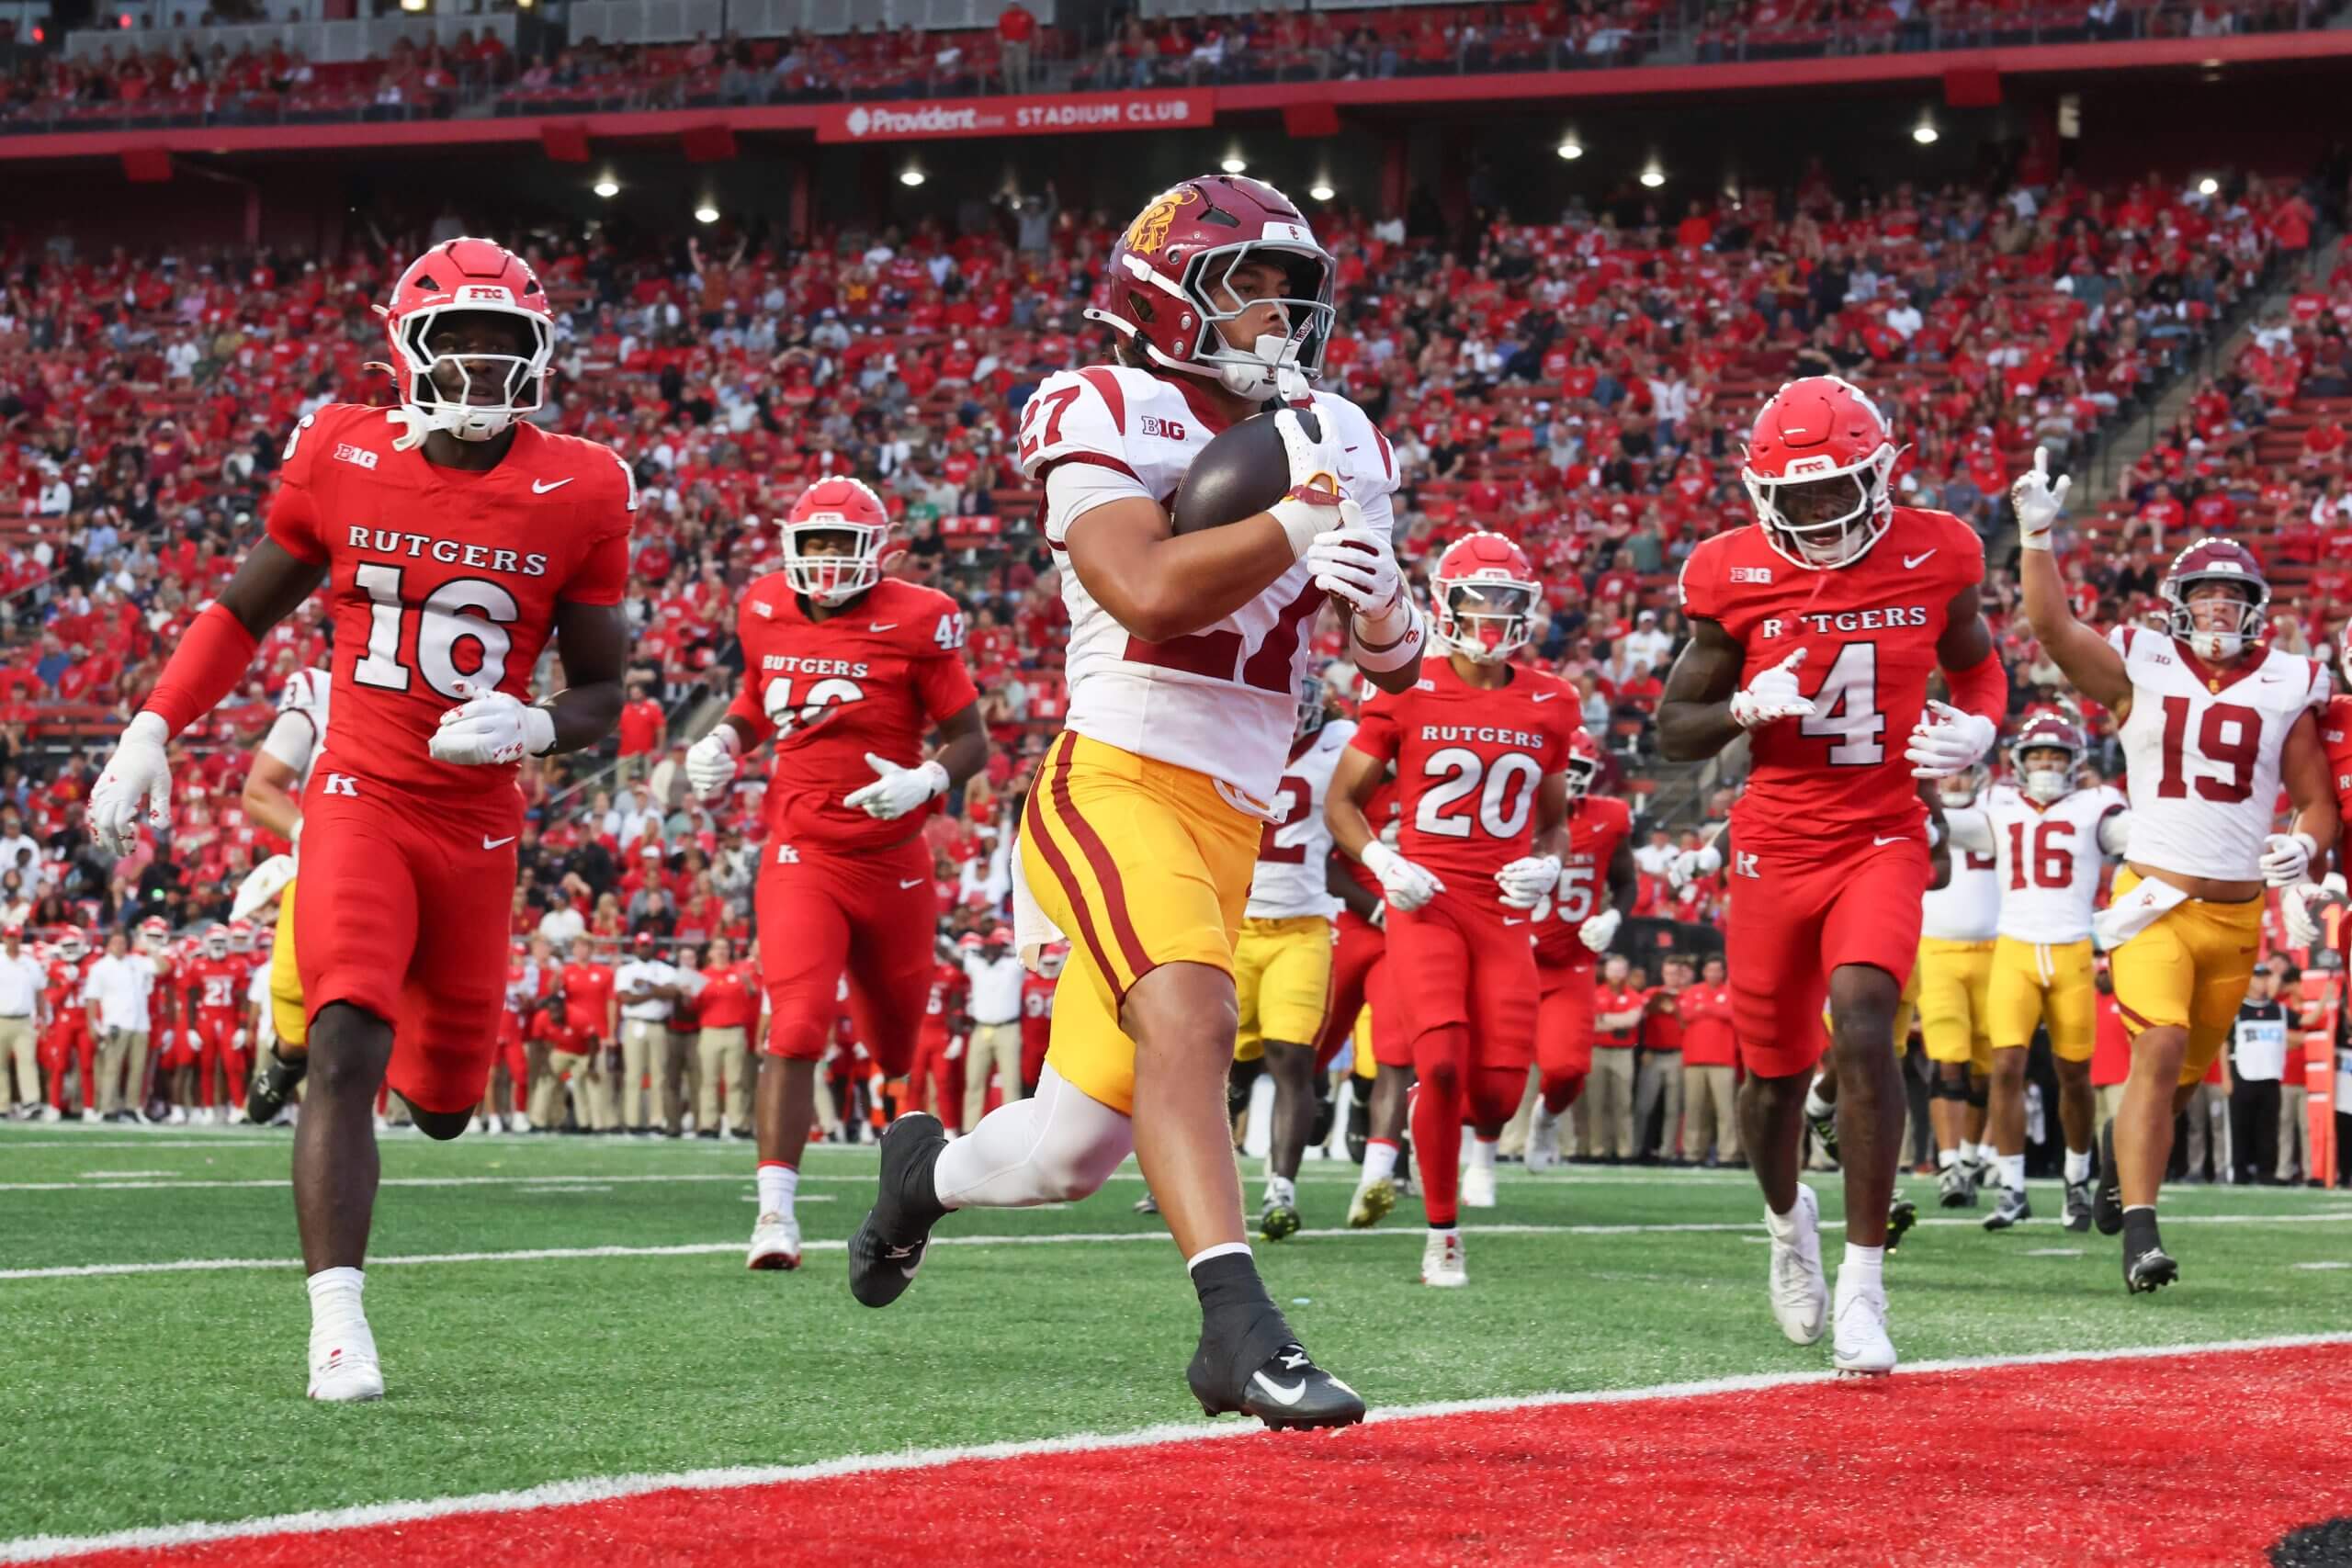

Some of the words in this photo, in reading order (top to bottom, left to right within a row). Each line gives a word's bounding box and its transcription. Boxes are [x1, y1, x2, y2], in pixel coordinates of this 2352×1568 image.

[872, 105, 977, 132] Provident
[1016, 103, 1120, 127] STADIUM
[1126, 100, 1189, 122] CLUB
[1018, 385, 1081, 466] 27
[1313, 491, 1338, 502] USC
[347, 525, 549, 577] RUTGERS
[353, 560, 520, 703] 16
[934, 613, 965, 651] 42
[1762, 605, 1927, 639] RTGERS
[763, 654, 868, 678] RUTGERS
[1801, 640, 1886, 767] 4
[1421, 724, 1544, 750] RUTGERS
[2157, 695, 2263, 805] 19
[1414, 748, 1544, 840] 20
[2007, 820, 2076, 891] 16
[2320, 903, 2342, 950] 1
